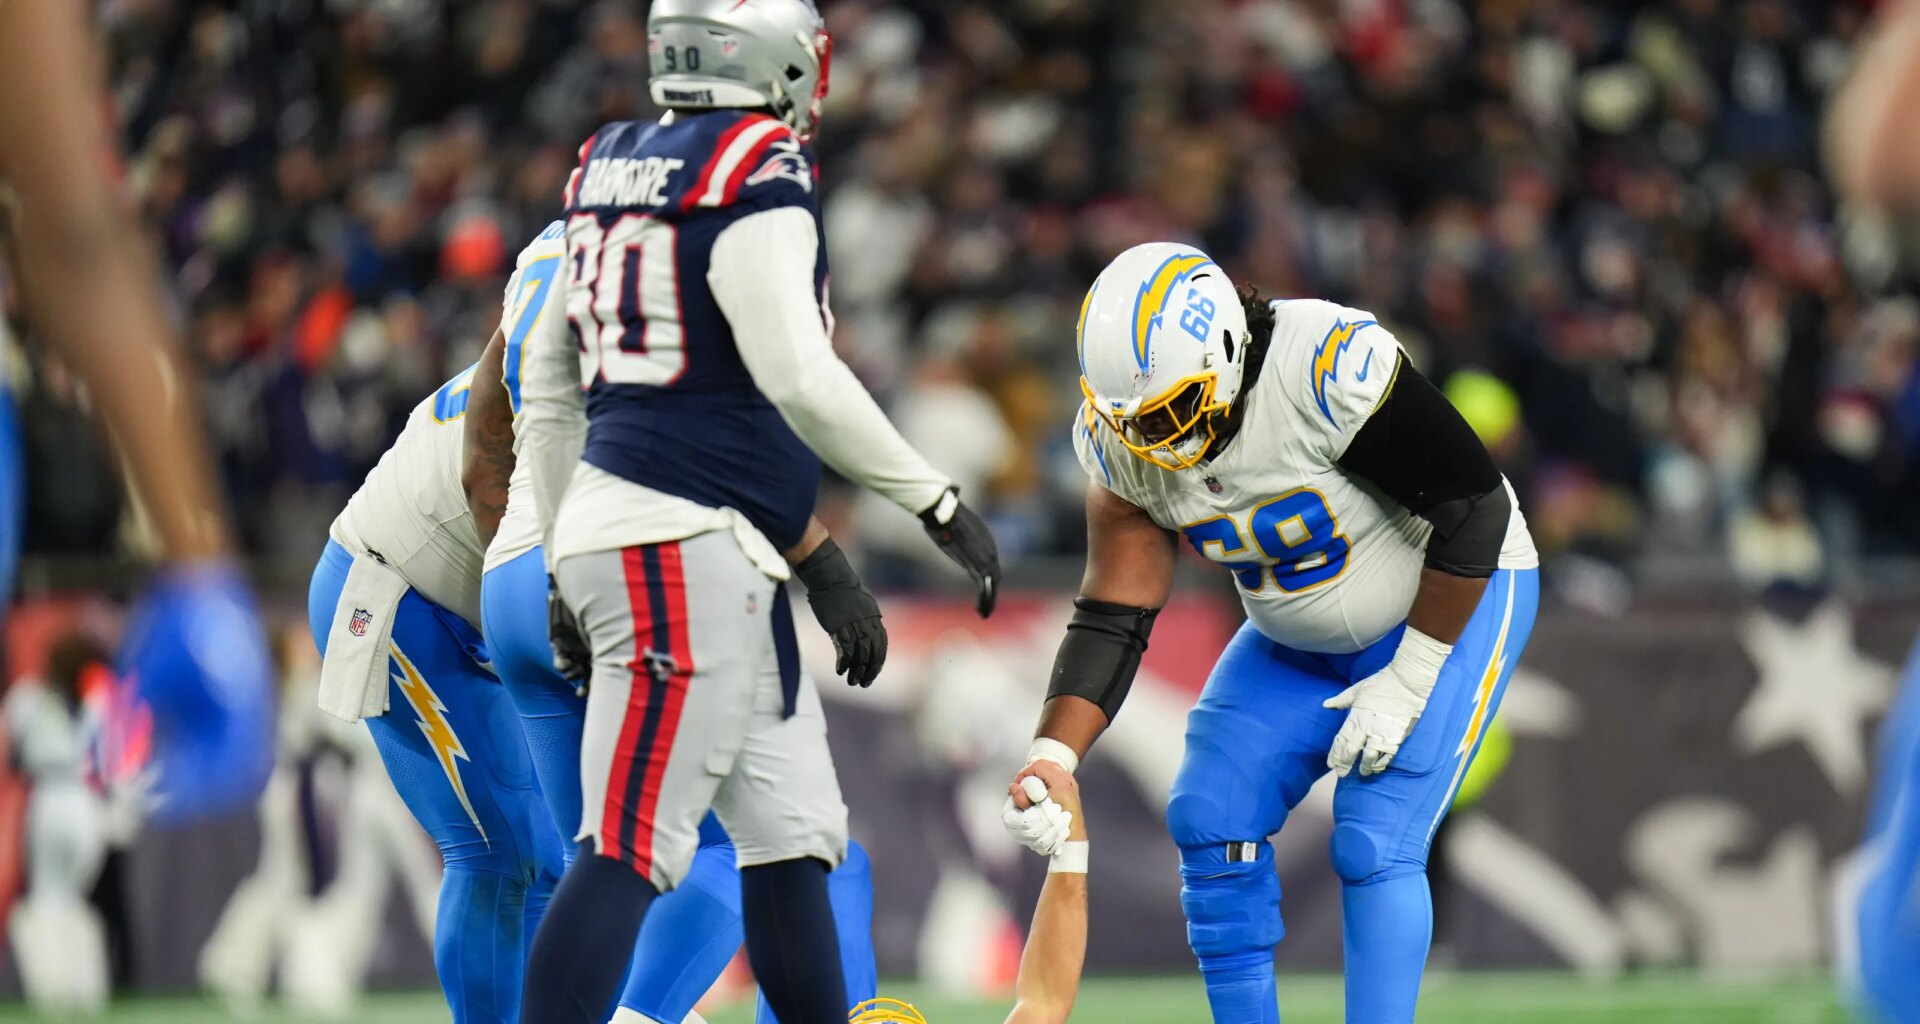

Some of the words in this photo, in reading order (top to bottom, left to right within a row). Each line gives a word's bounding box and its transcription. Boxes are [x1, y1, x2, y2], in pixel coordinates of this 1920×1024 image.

[664, 45, 700, 71] 90
[566, 211, 689, 391] 90
[1179, 288, 1216, 343] 68
[1178, 486, 1352, 595] 68
[351, 618, 366, 634] NFL
